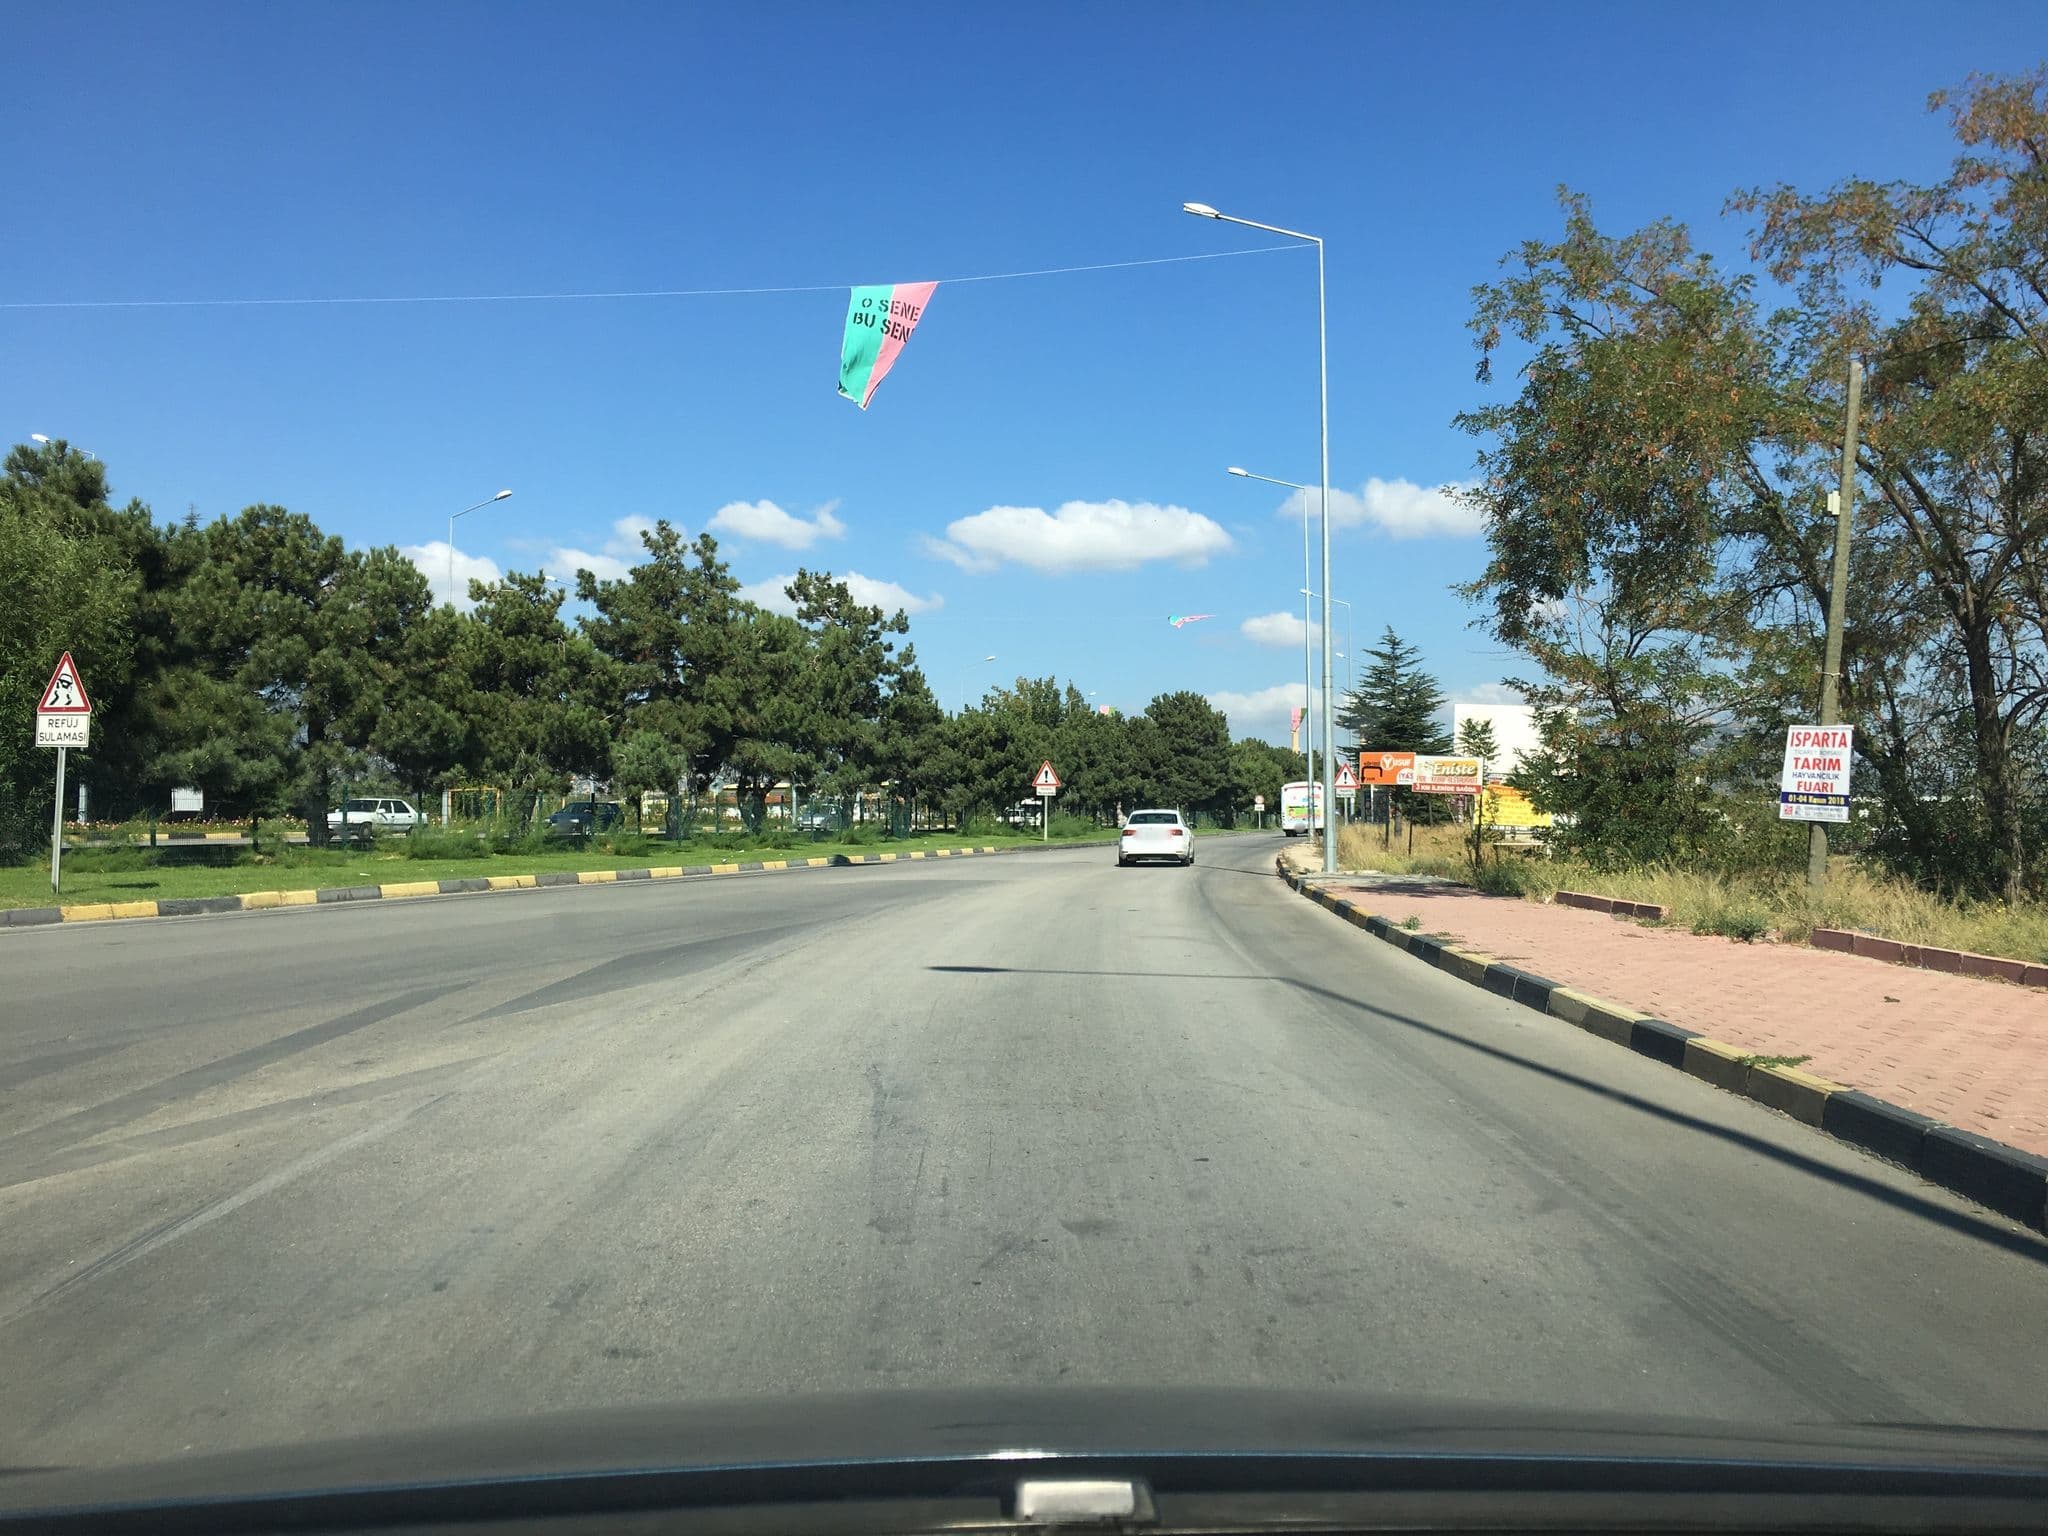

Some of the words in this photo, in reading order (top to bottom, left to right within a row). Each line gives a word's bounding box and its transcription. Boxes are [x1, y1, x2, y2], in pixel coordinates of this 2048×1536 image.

[861, 298, 873, 309] O
[878, 300, 921, 322] SENE
[853, 312, 876, 328] BU
[880, 319, 915, 344] SEN
[39, 732, 86, 742] SULAMASI
[1790, 731, 1848, 748] ISPARTA
[1793, 757, 1841, 771] TARIM
[1792, 771, 1840, 780] HAYVANCILIK
[1796, 781, 1834, 793] FUARI
[1788, 794, 1807, 803] 01-04
